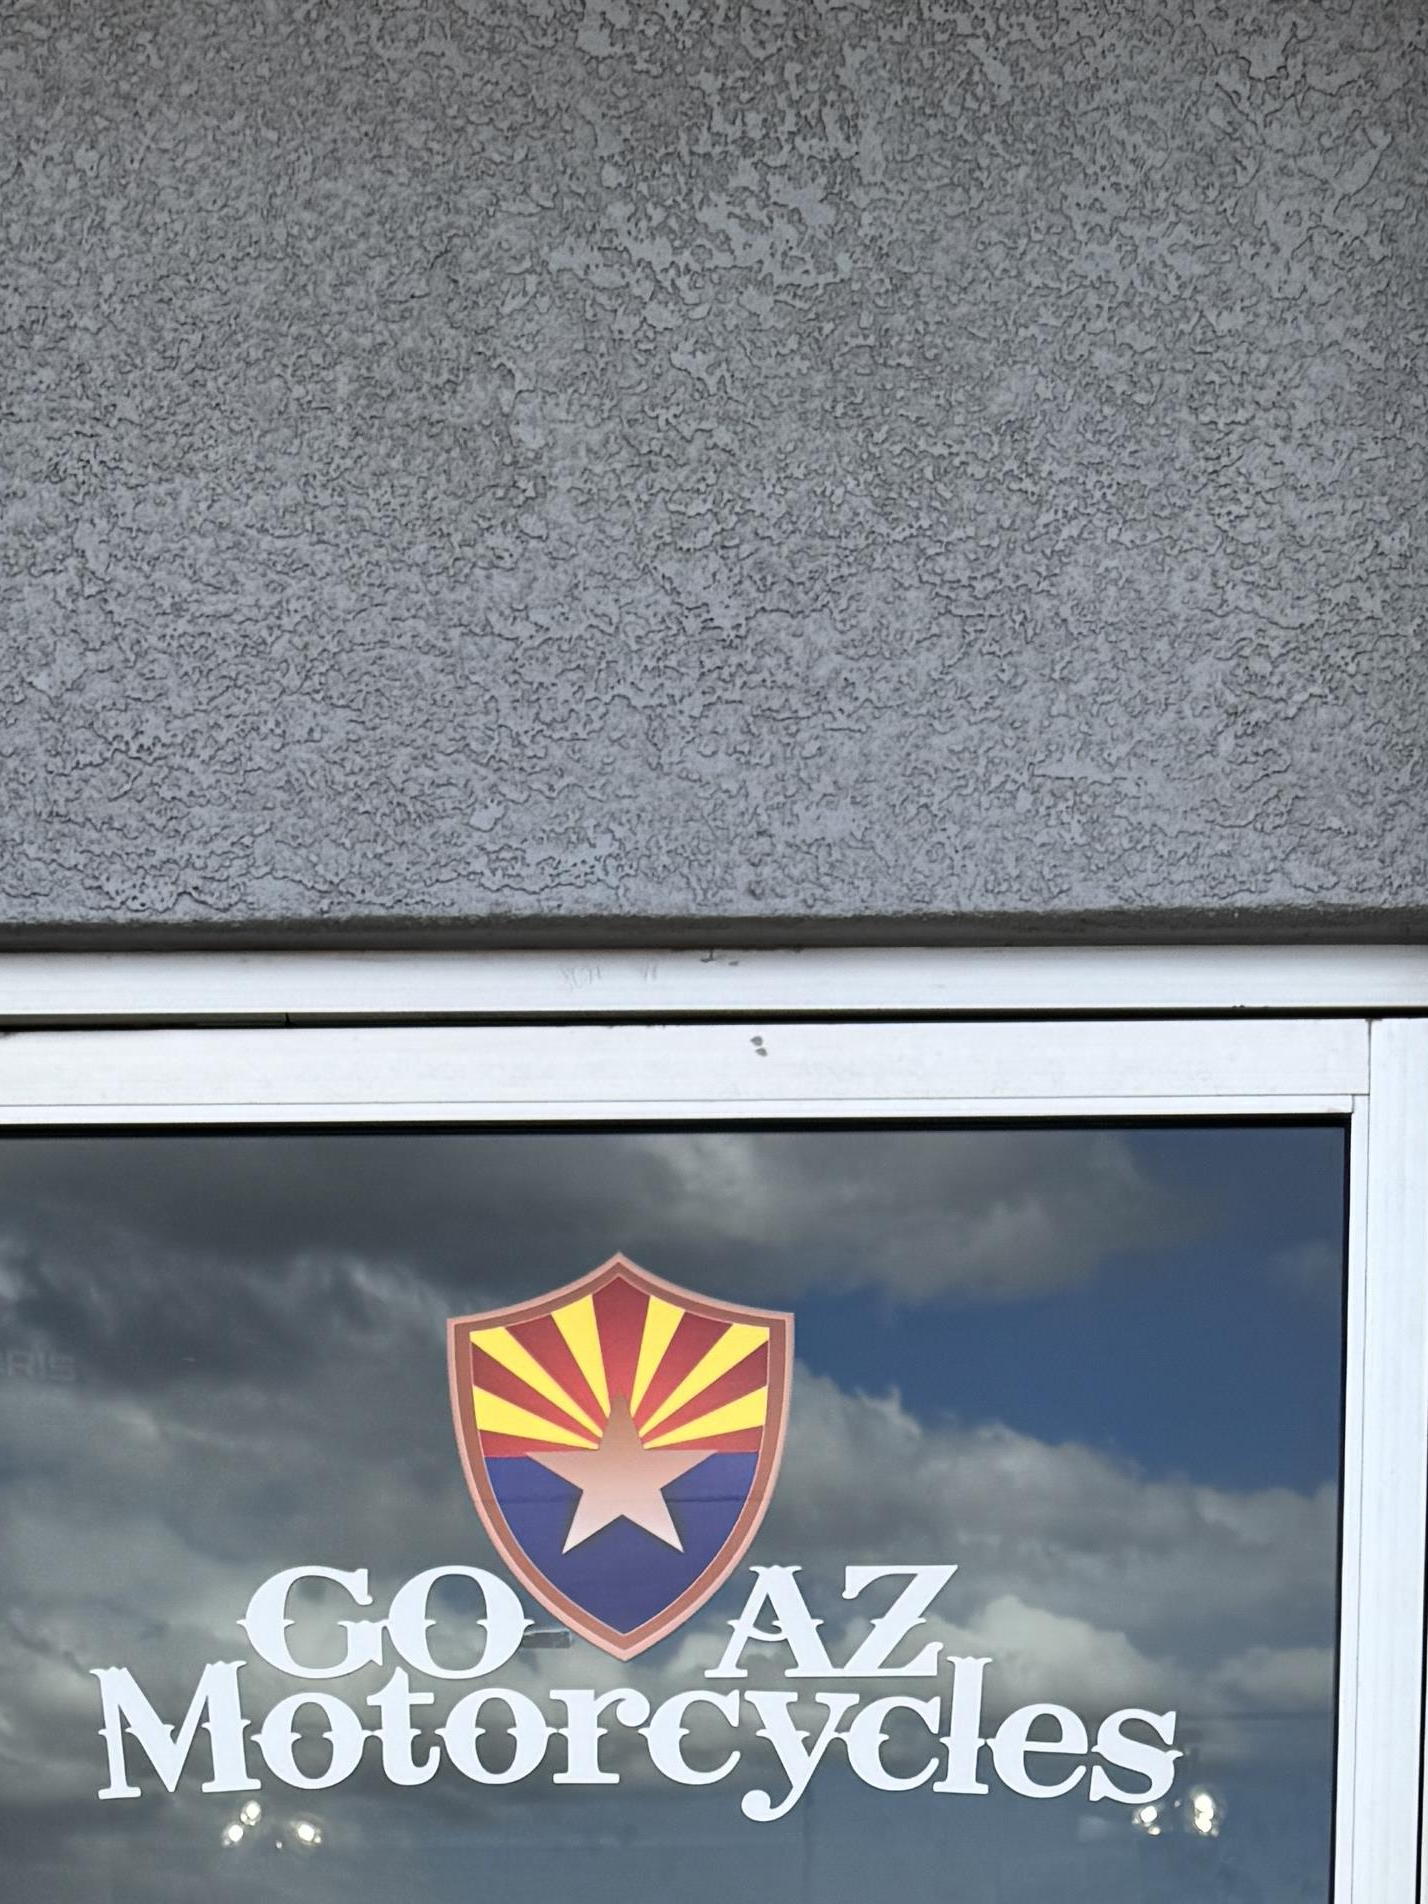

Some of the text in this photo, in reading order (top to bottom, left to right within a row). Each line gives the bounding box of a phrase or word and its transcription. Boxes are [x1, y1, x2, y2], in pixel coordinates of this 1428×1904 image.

[238, 1564, 961, 1680] GO AZ
[90, 1655, 1179, 1822] Motorcycles
